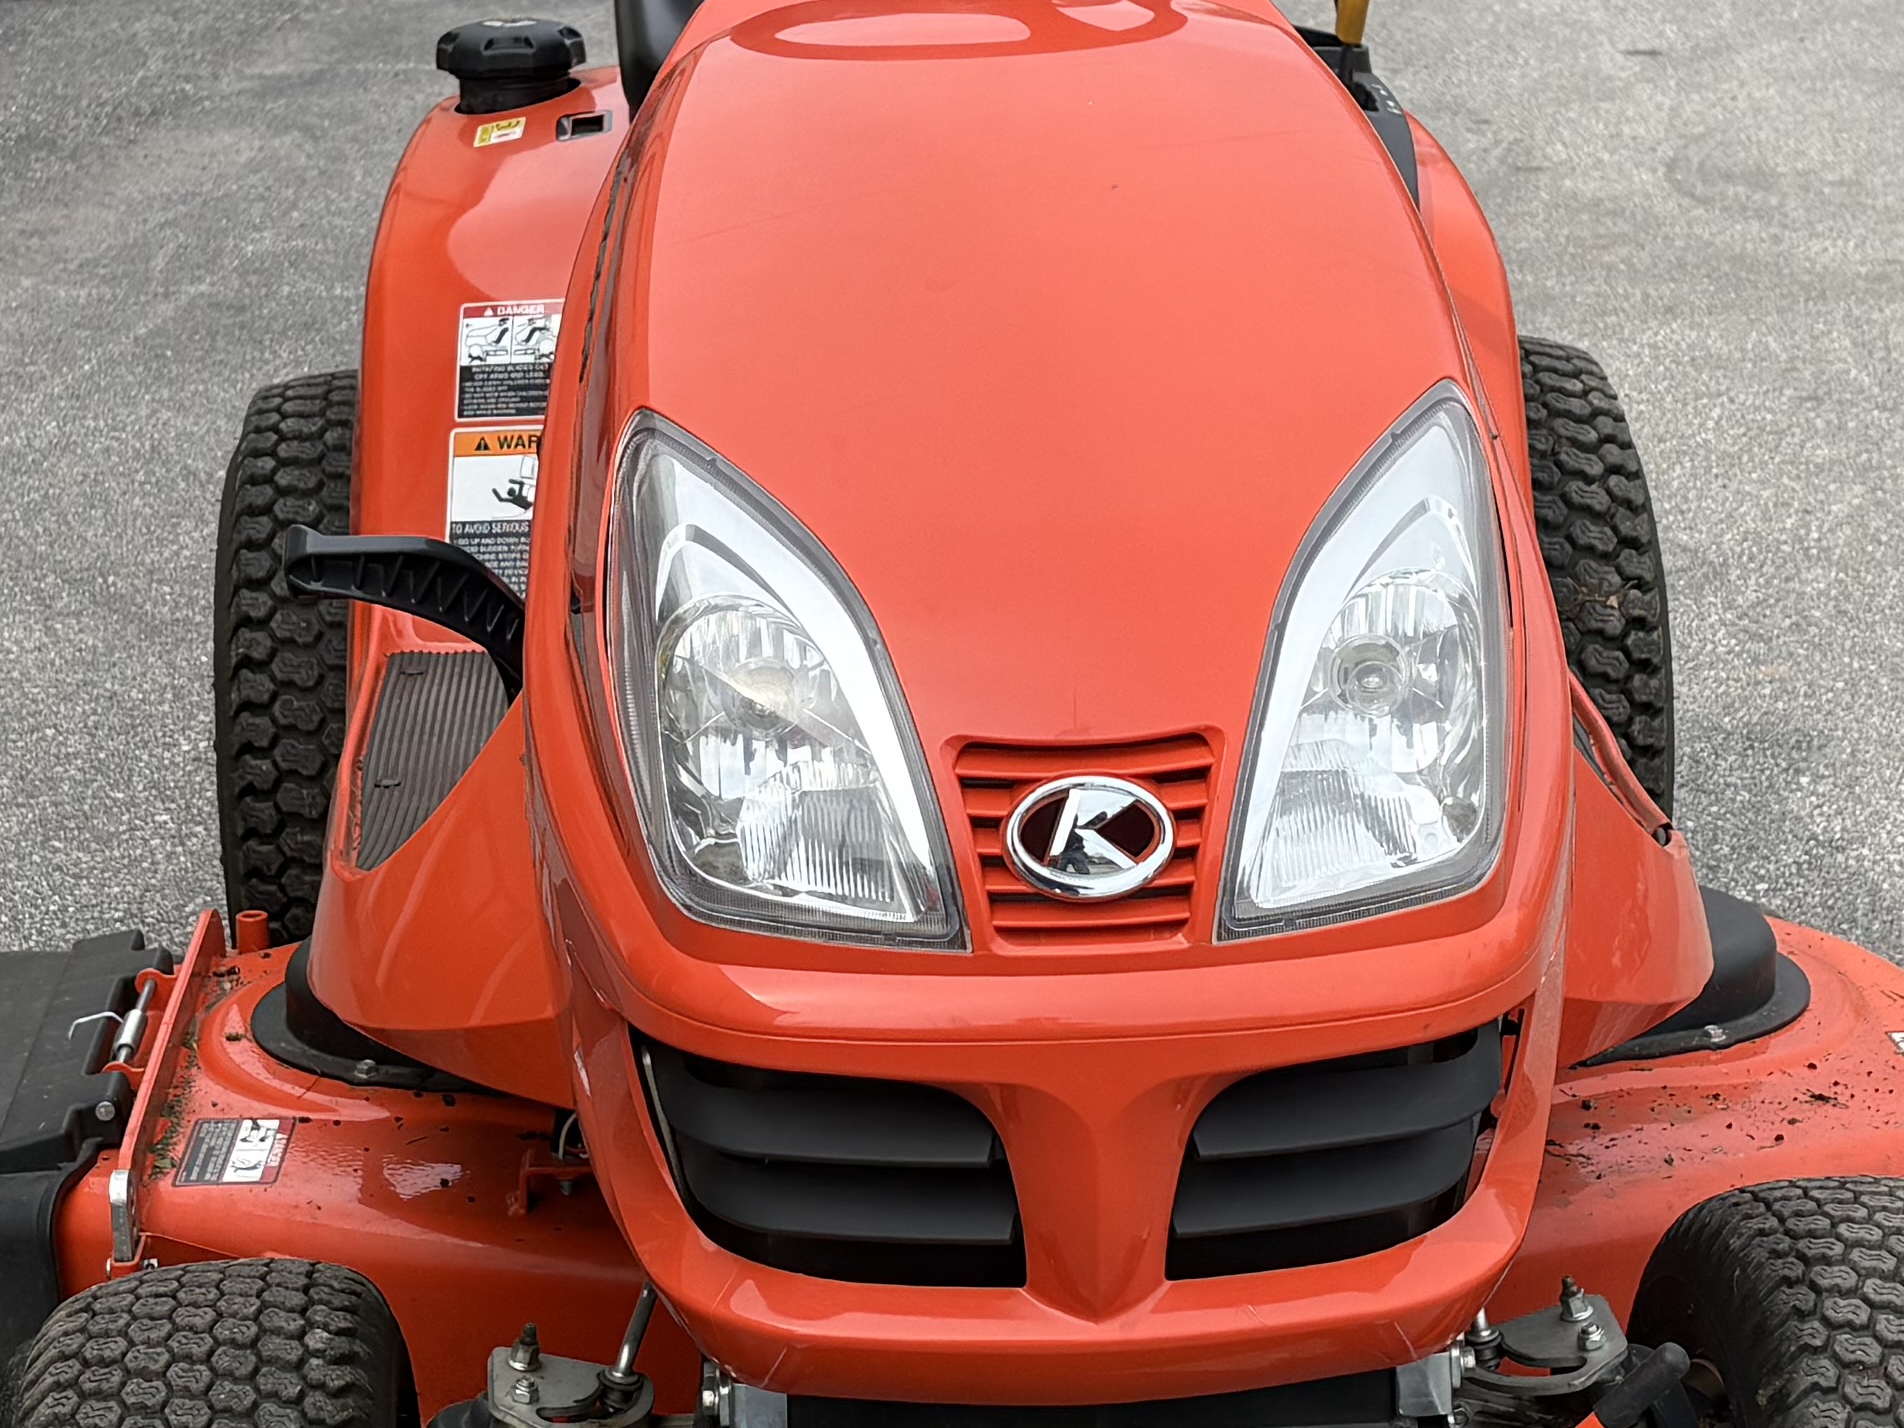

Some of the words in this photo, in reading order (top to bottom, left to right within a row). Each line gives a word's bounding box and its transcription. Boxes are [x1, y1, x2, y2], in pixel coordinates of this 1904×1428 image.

[496, 304, 545, 315] DANGER
[452, 523, 463, 534] TO
[464, 522, 491, 534] AVOID
[491, 522, 530, 534] SERIOUS
